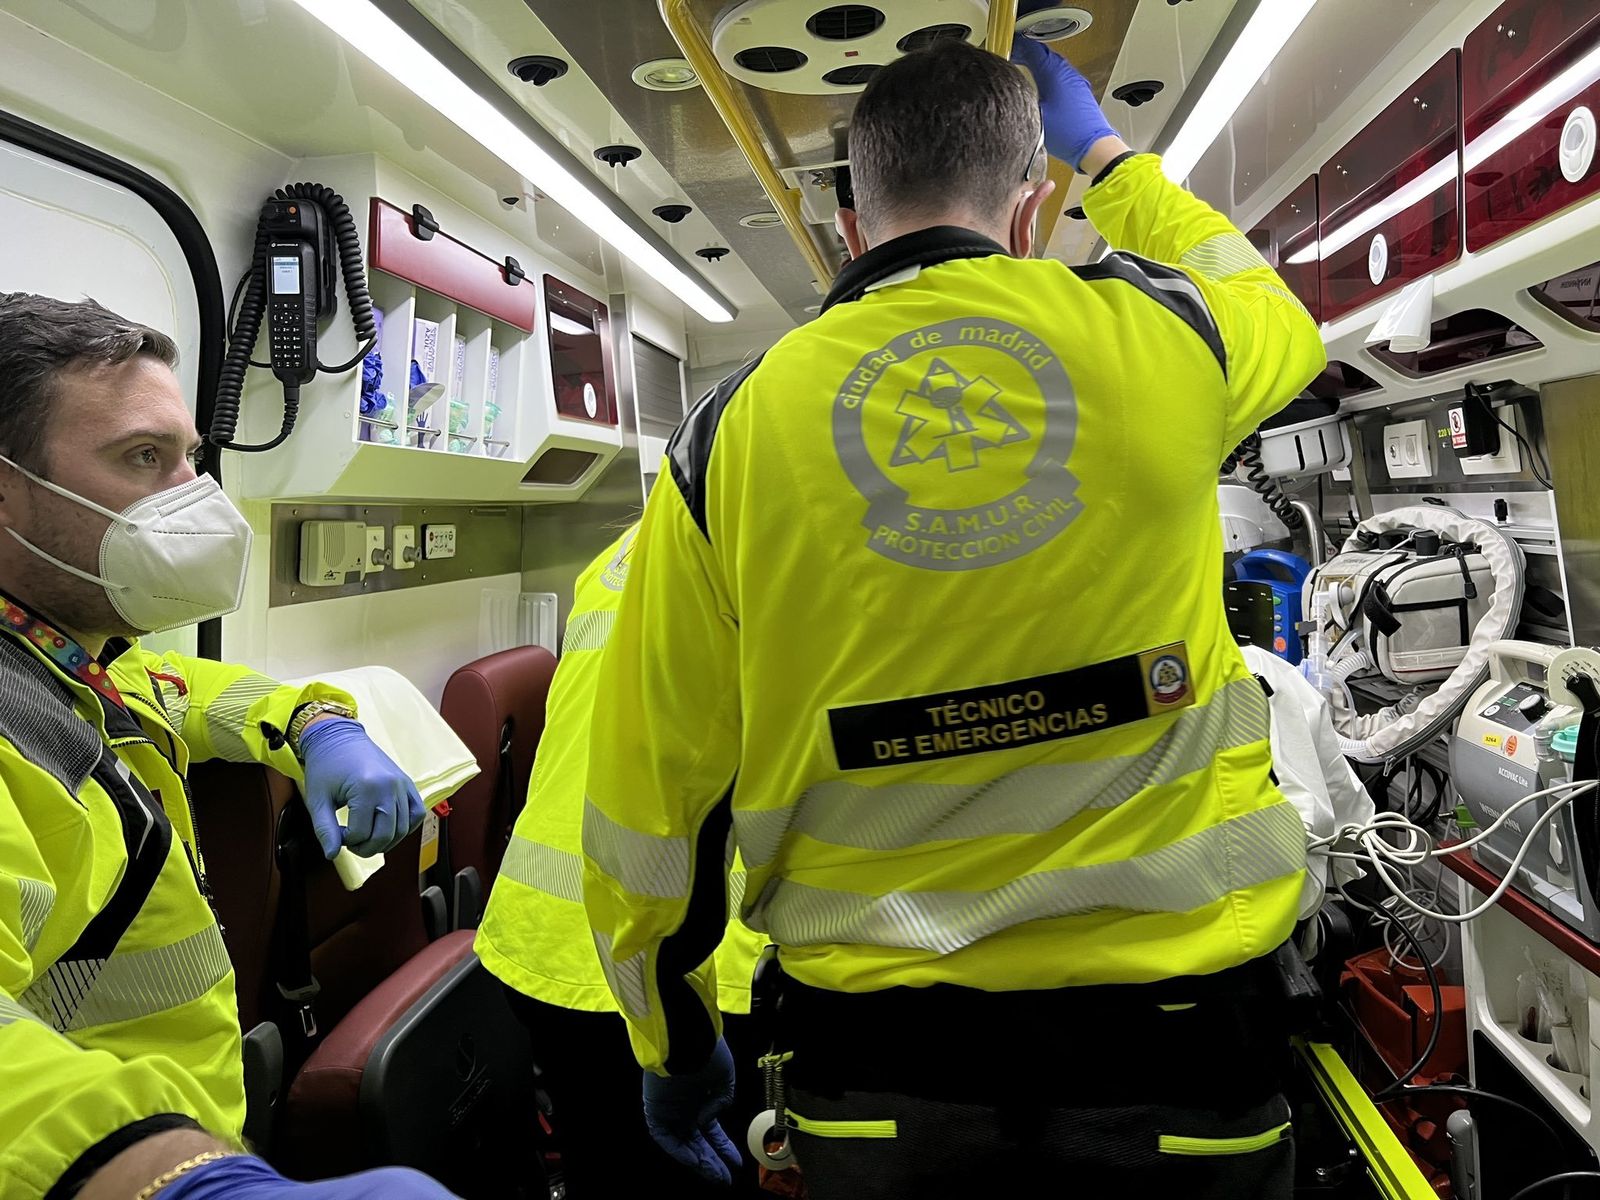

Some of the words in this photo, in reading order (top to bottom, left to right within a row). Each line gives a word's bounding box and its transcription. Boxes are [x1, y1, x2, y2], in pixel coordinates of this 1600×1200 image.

[840, 350, 898, 409] ciudad
[910, 331, 943, 349] de
[959, 325, 1053, 371] madrid
[873, 525, 1021, 560] PROTECCION
[1022, 498, 1074, 538] CIVIL
[904, 495, 1042, 535] S.A.M.U.R.
[872, 737, 911, 760] DE
[914, 703, 1109, 756] EMERGENCIAS
[925, 690, 1045, 727] TÉCNICO
